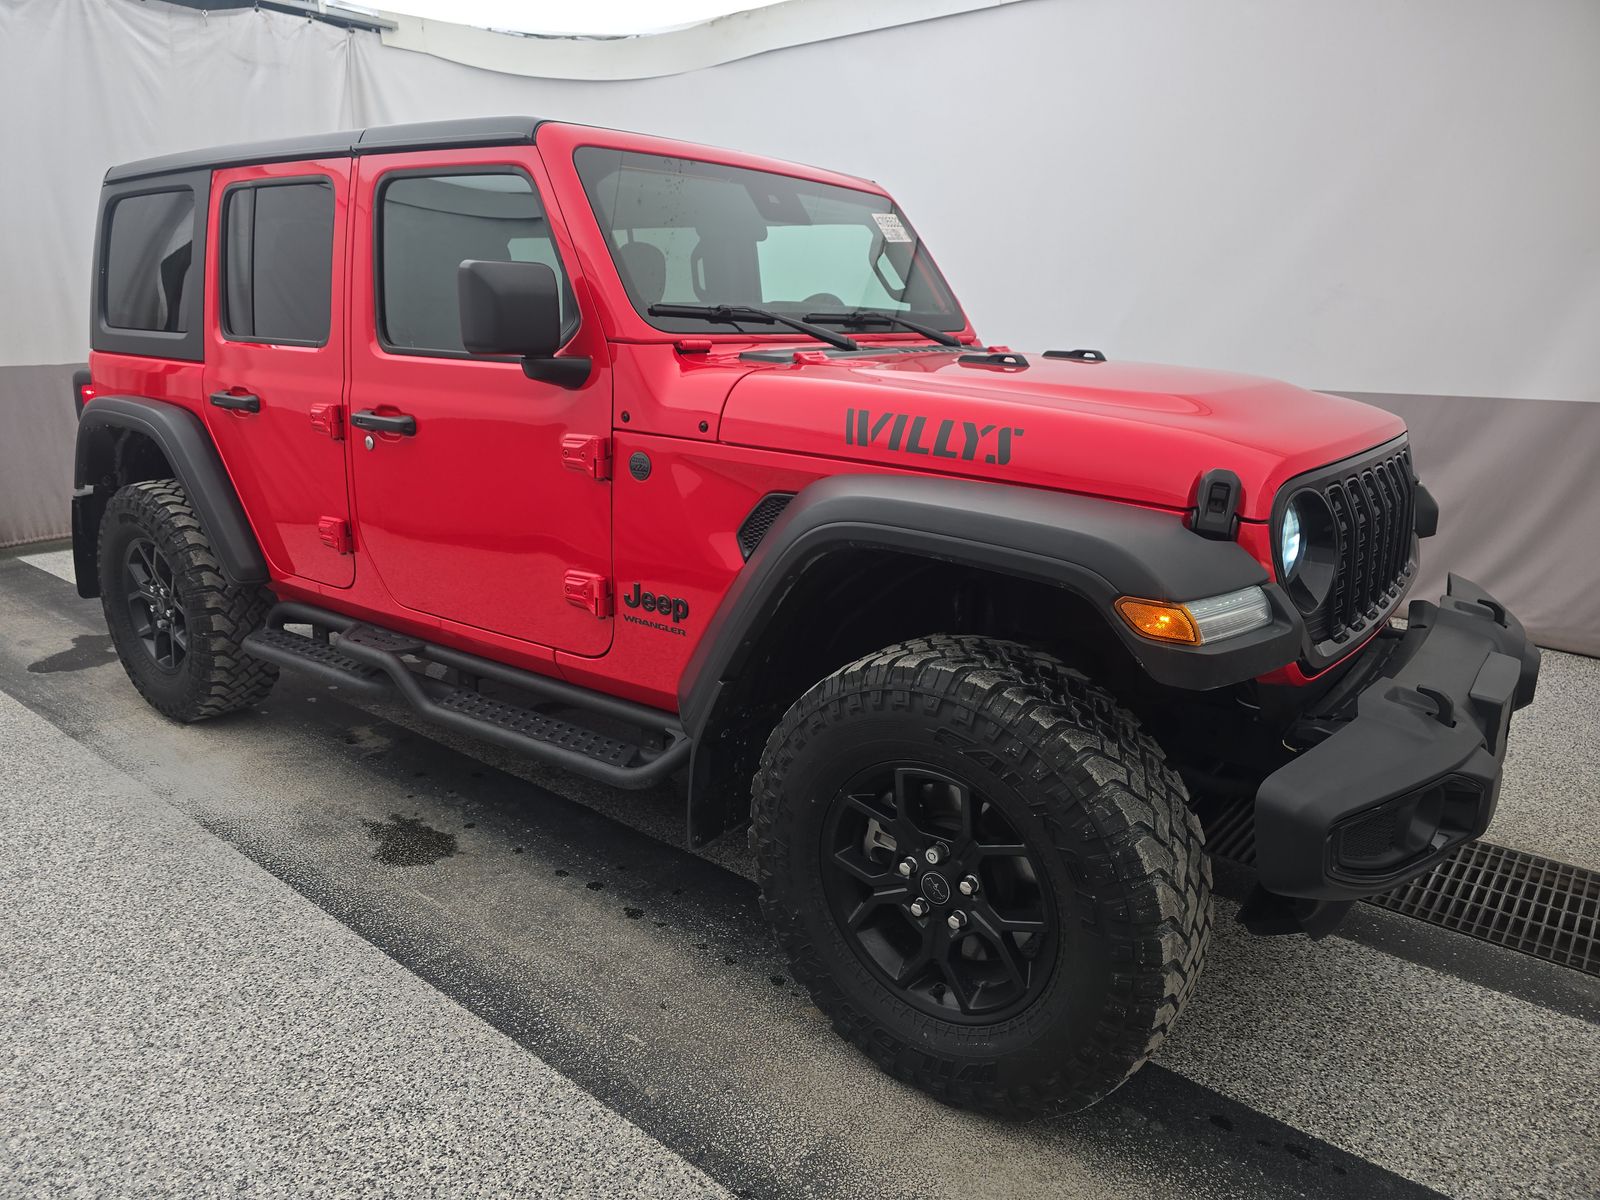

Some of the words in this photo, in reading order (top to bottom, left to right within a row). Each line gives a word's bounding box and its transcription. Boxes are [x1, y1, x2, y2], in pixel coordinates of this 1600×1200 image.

[845, 408, 1024, 465] WILLYS
[623, 582, 689, 624] Jeep
[623, 613, 686, 637] WRANGLER
